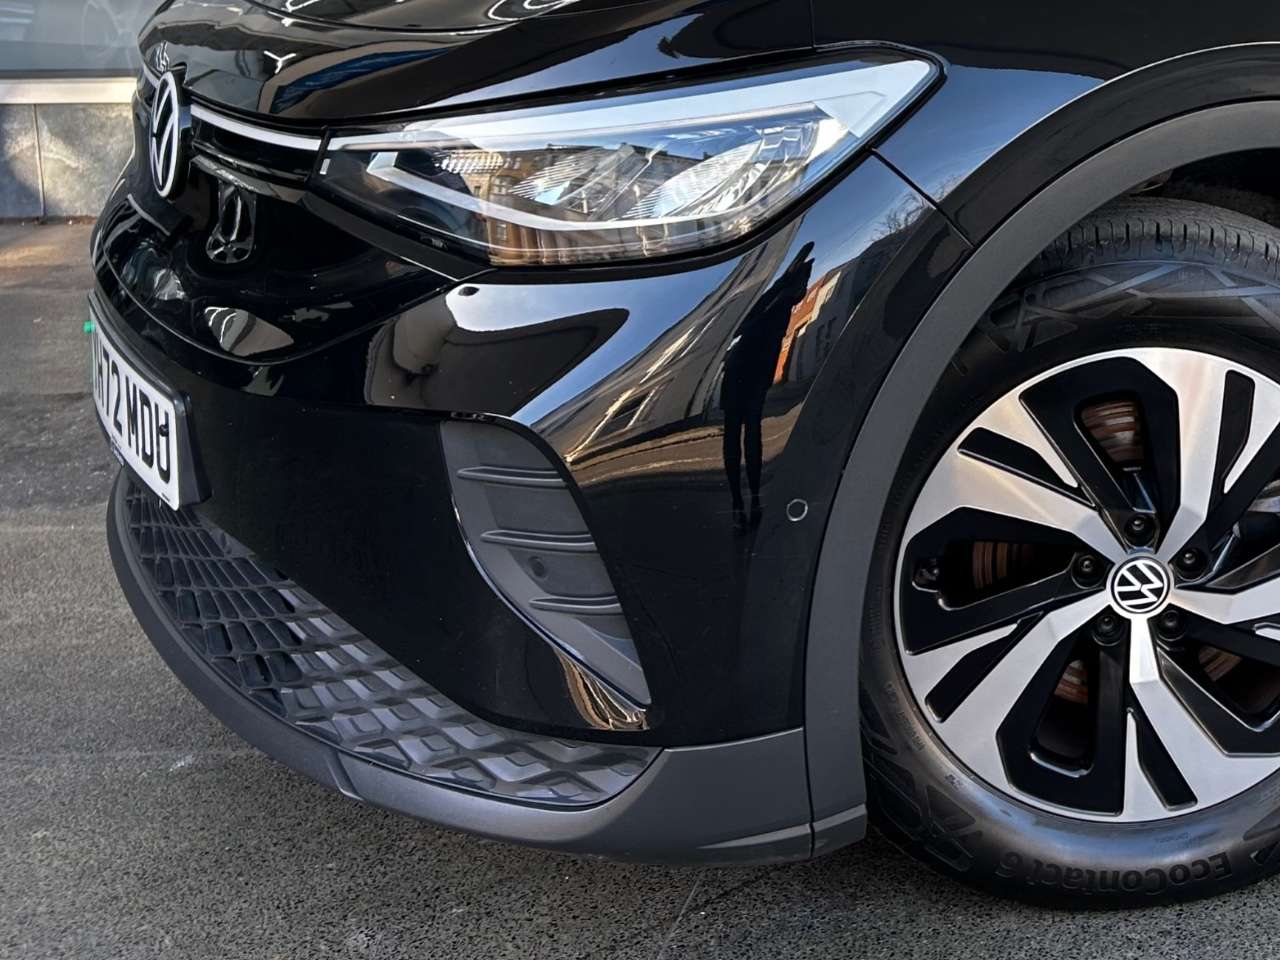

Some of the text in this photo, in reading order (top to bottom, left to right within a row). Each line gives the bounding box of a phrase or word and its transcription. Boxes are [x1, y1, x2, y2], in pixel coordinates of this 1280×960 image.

[126, 375, 171, 484] MDU
[995, 851, 1233, 896] EcoContact 6
